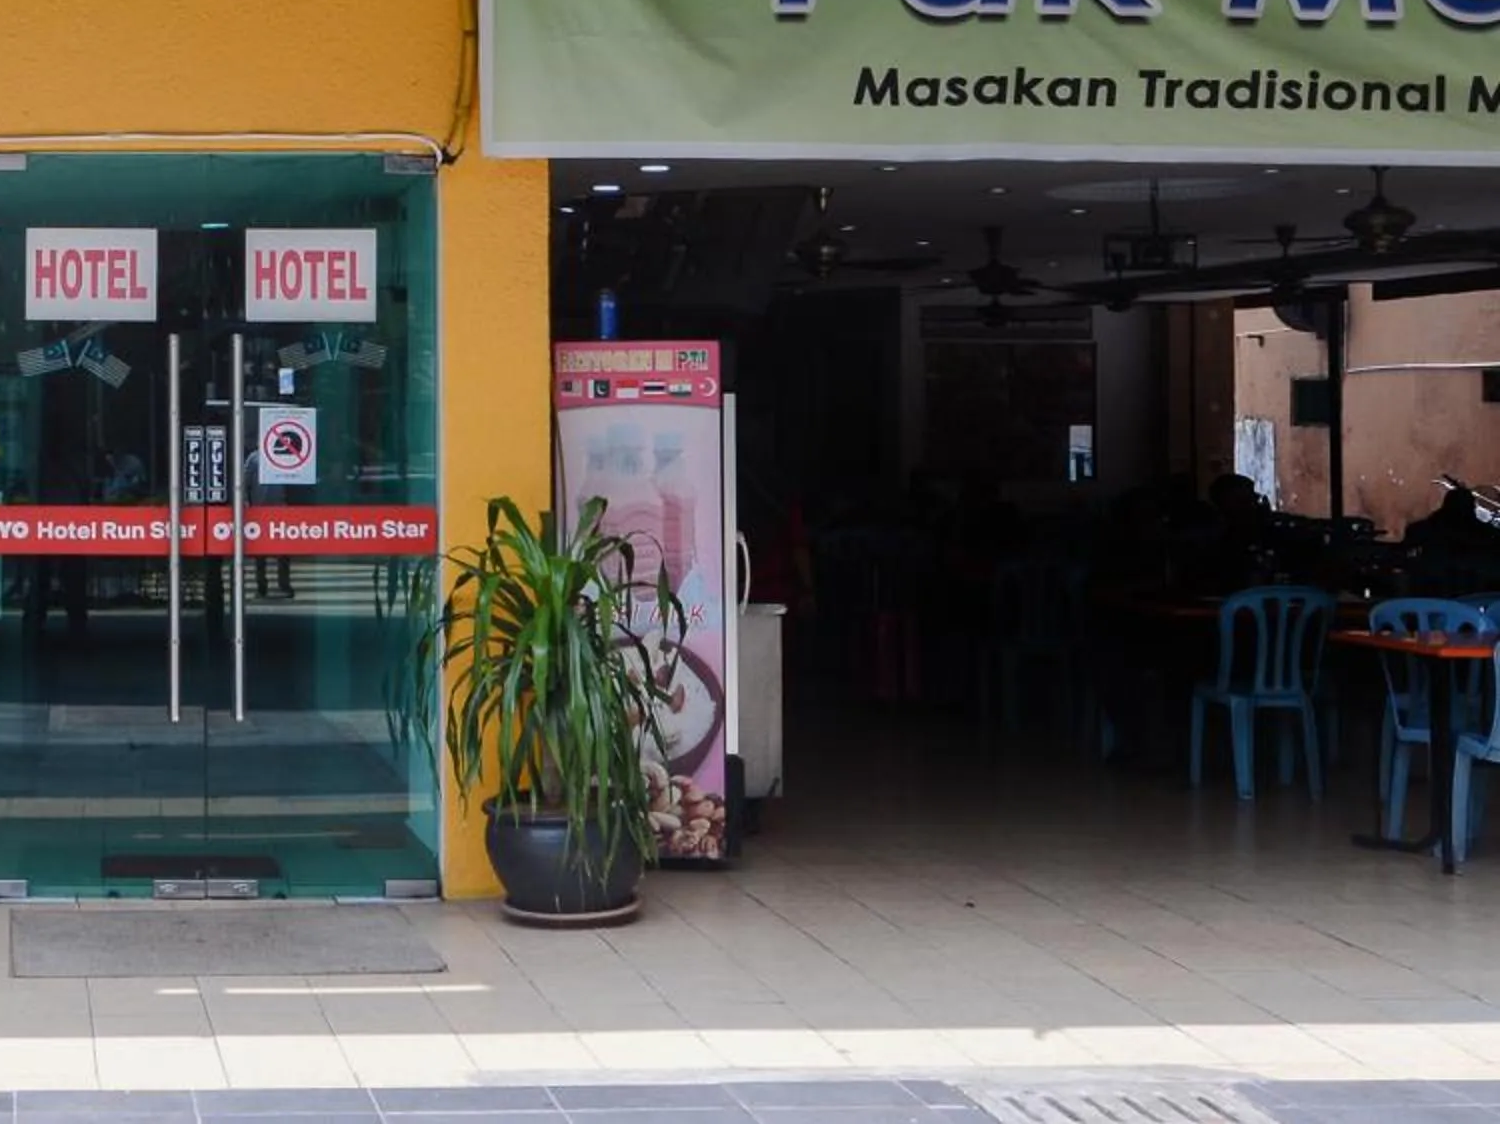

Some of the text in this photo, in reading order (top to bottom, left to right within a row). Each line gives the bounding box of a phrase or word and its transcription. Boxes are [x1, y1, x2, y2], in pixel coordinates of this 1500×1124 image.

[853, 67, 1117, 108] Masakan
[1139, 69, 1446, 112] Tradisional
[35, 249, 147, 299] HOTEL
[254, 250, 367, 300] HOTEL
[189, 441, 199, 487] PULL
[211, 441, 222, 487] PULL
[37, 521, 97, 539] Hotel
[102, 521, 145, 539] Run
[213, 520, 428, 540] OO Hotel Run Star
